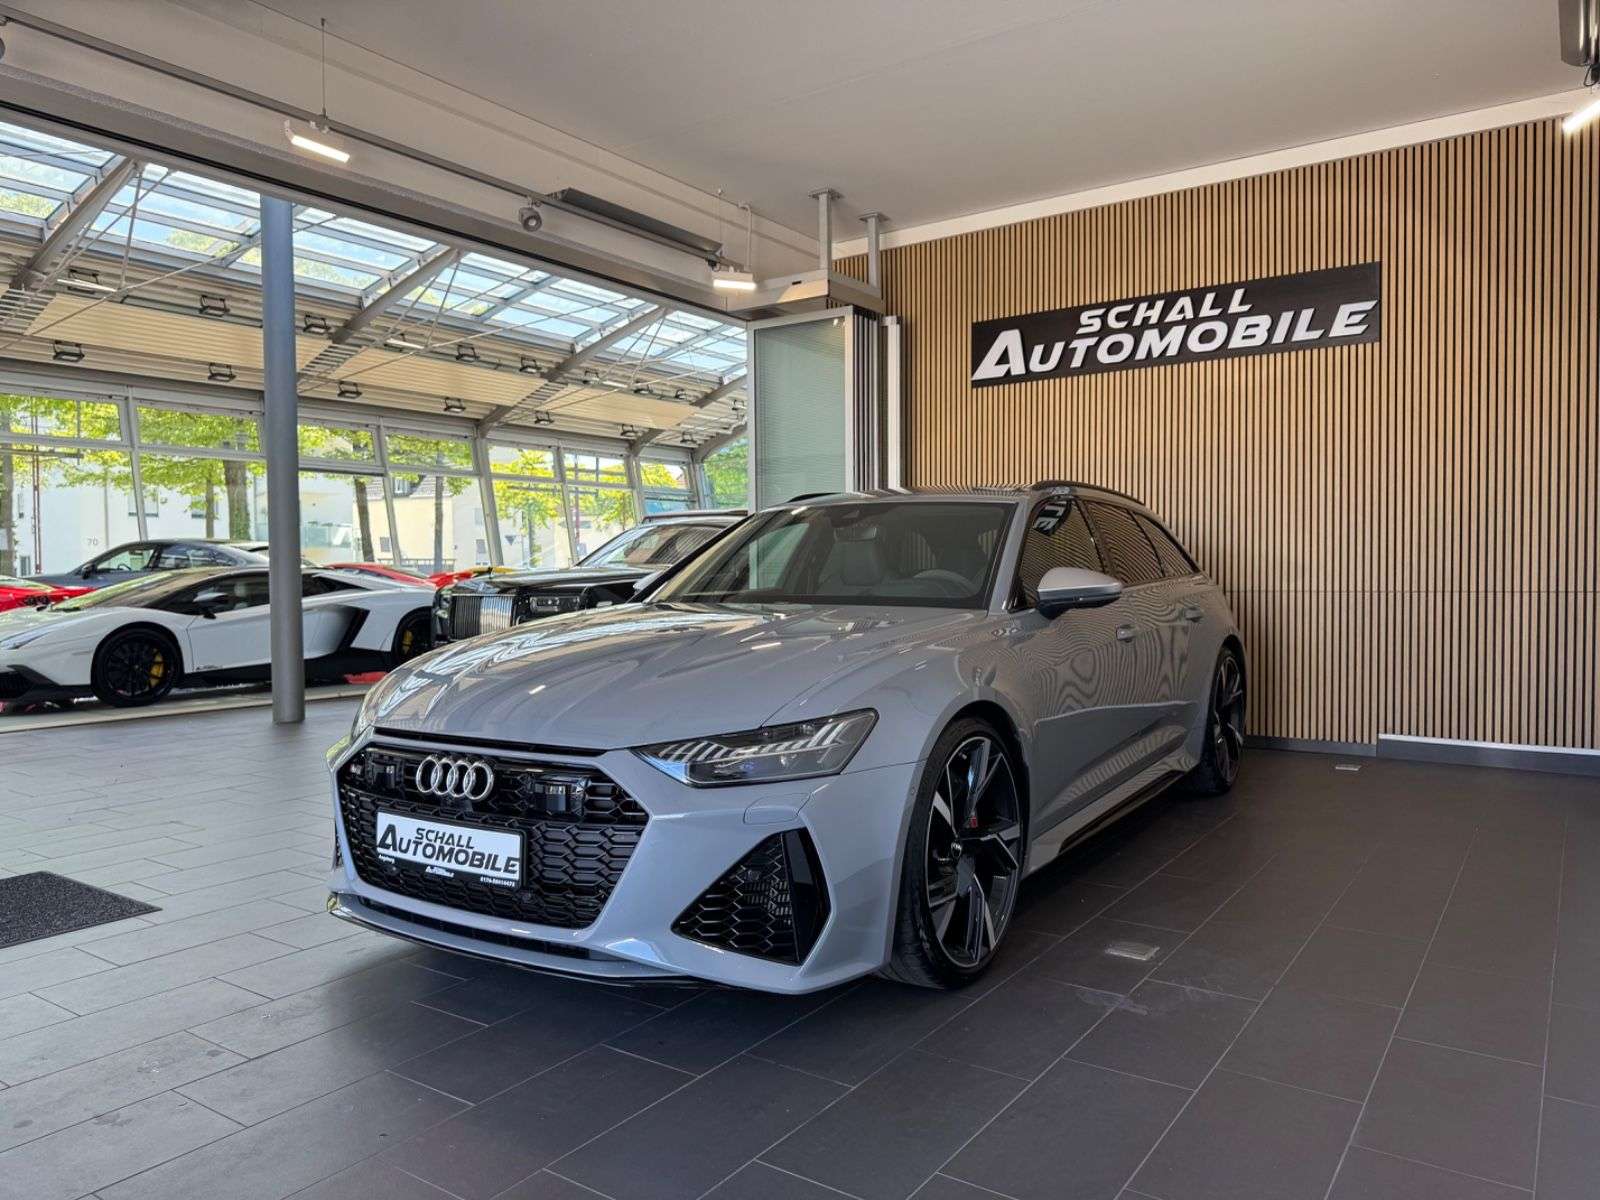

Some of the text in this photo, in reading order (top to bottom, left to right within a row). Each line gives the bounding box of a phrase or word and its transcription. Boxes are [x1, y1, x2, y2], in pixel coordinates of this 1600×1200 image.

[1076, 288, 1252, 335] SCHALL
[971, 300, 1378, 381] AUTOMOBILE
[378, 824, 519, 873] AUTOMOBILE
[414, 827, 475, 850] SCHALL
